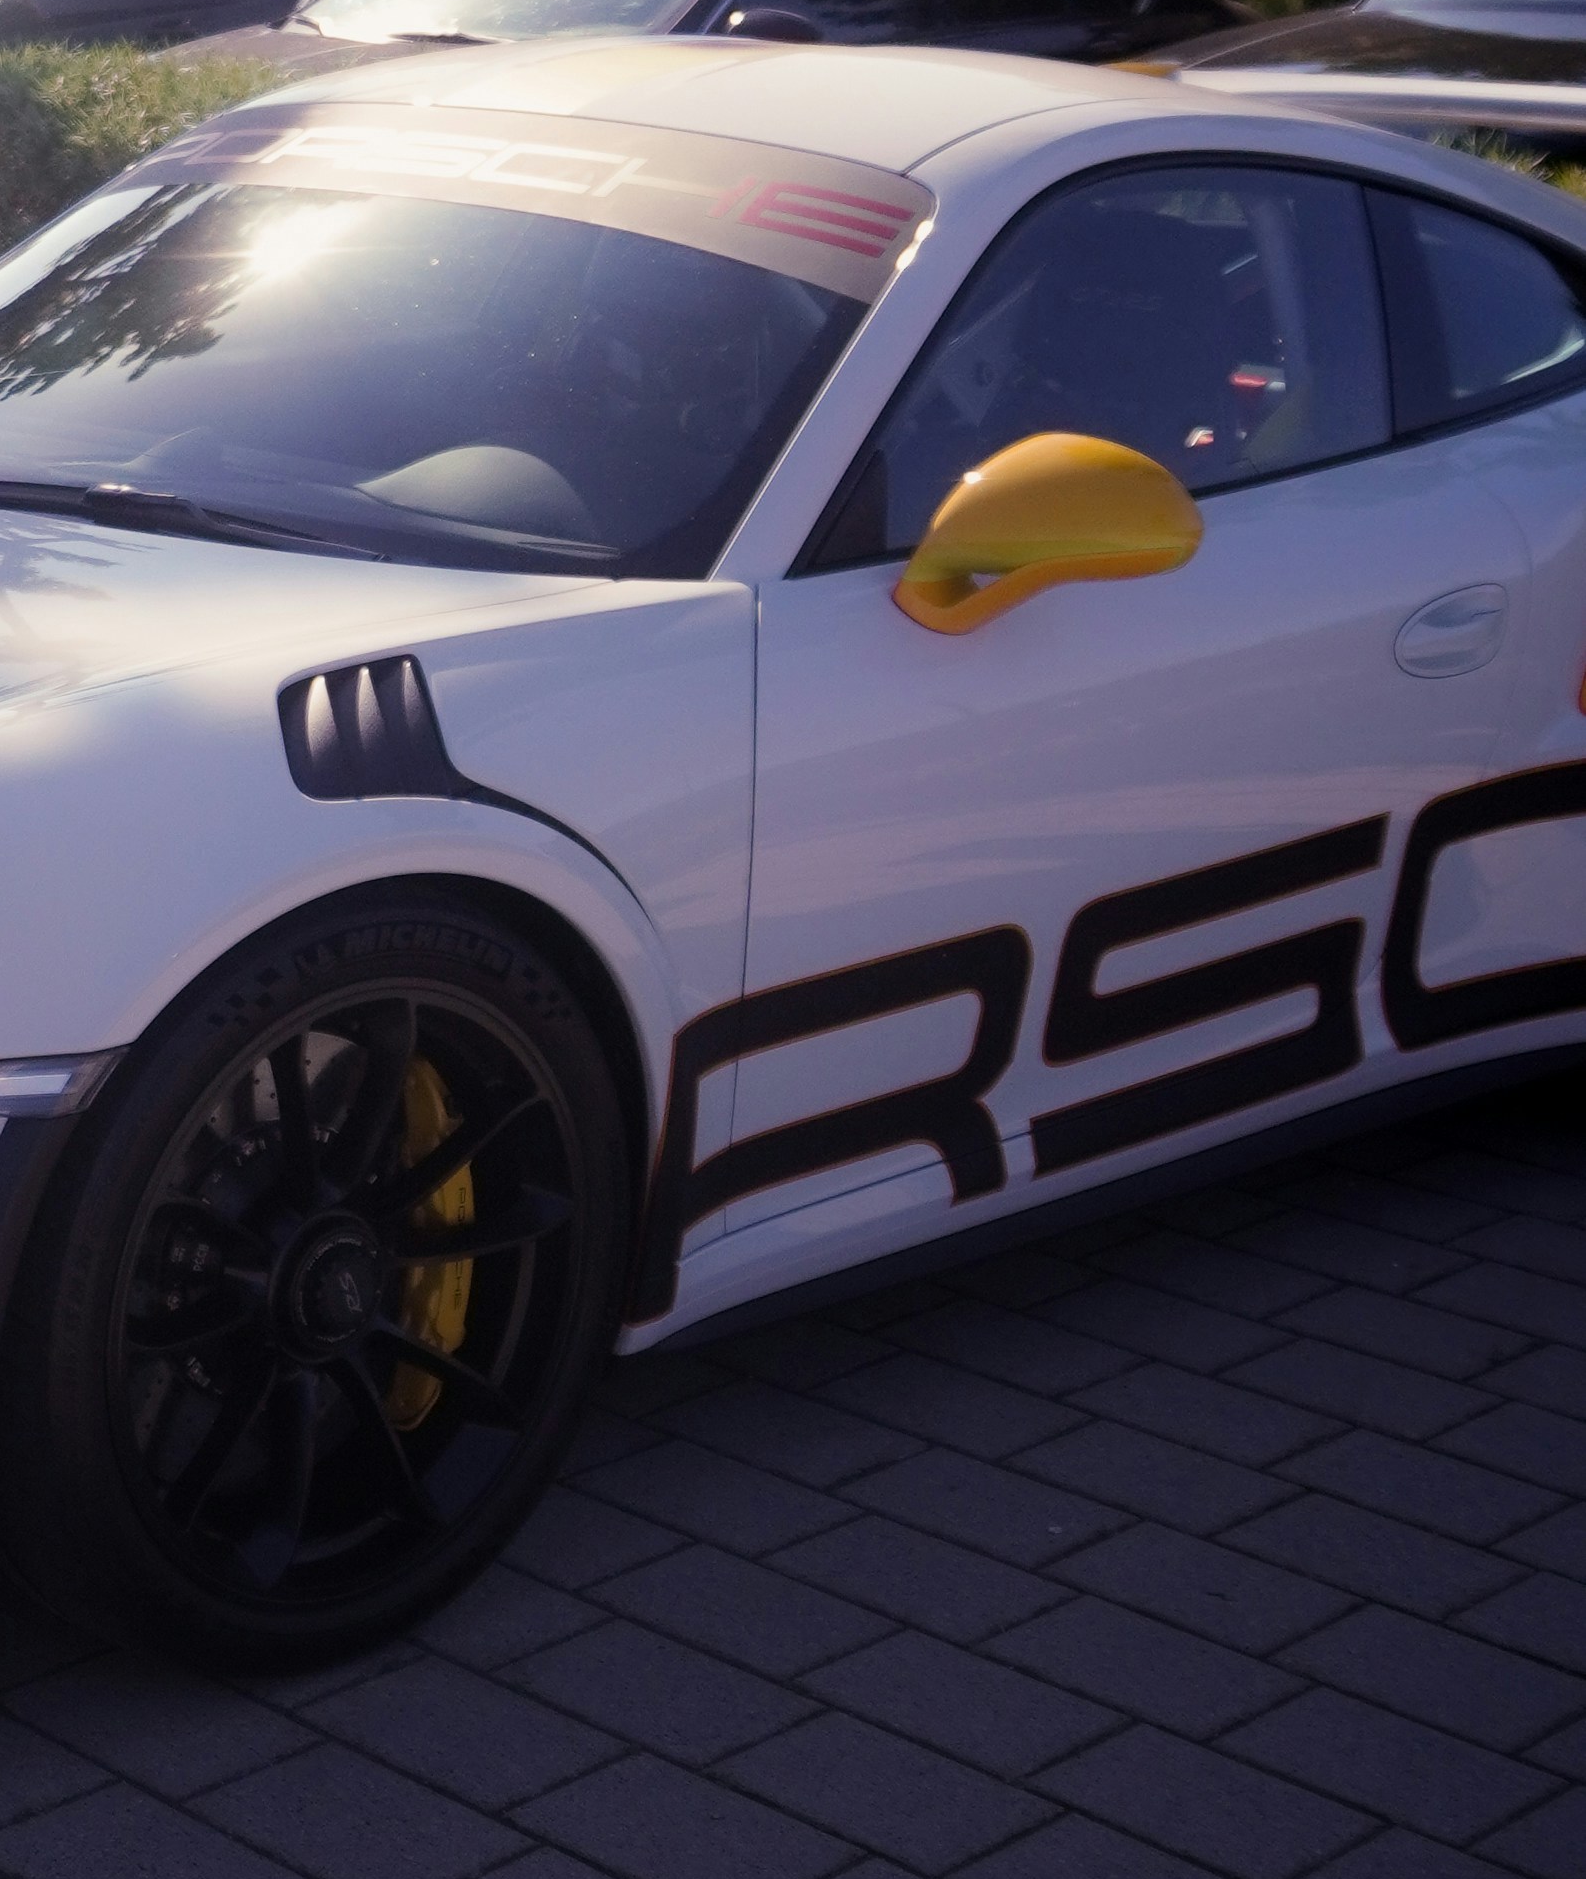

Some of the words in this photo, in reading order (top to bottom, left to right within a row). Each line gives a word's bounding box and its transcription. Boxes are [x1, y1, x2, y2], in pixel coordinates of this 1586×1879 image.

[133, 126, 916, 259] PORSCHE
[338, 1271, 363, 1313] RS
[454, 1187, 466, 1311] POCHE
